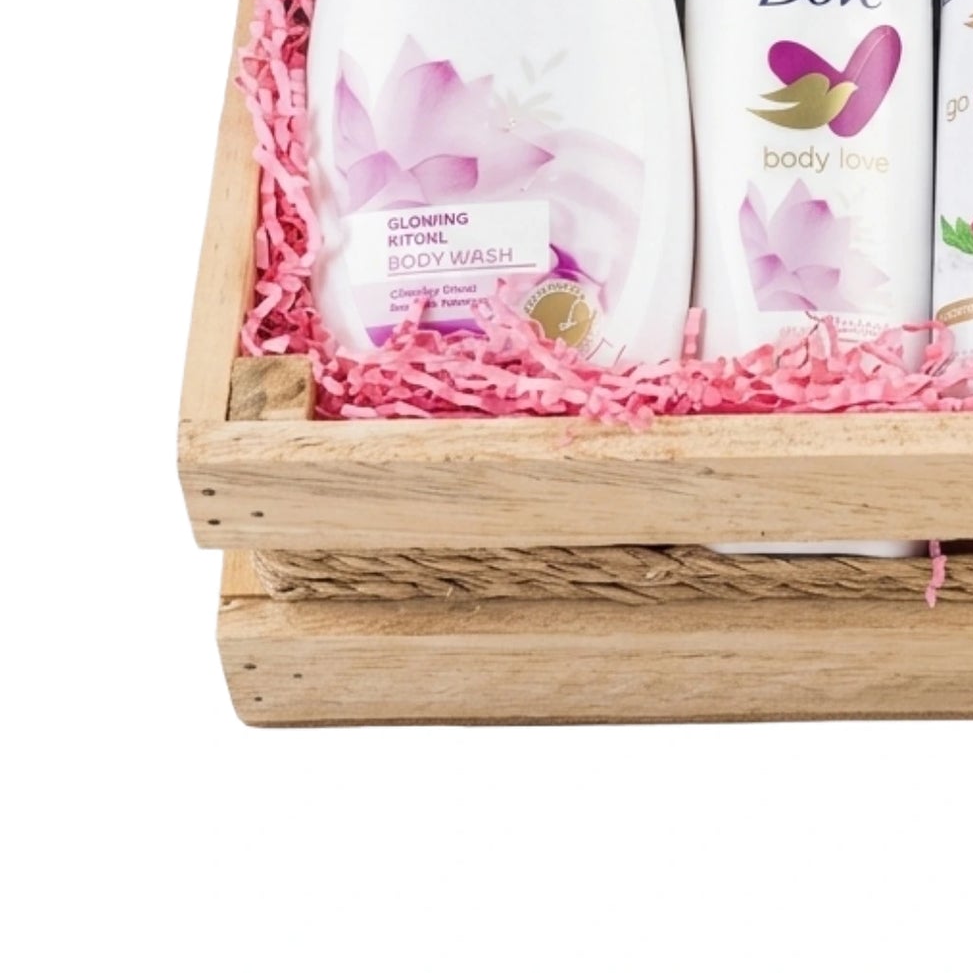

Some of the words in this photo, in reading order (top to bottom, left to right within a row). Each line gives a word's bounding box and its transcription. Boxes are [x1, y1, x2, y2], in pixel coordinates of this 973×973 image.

[945, 93, 969, 122] go
[763, 145, 830, 174] body
[838, 147, 890, 174] love
[388, 251, 445, 271] BODY
[449, 247, 513, 266] WASH
